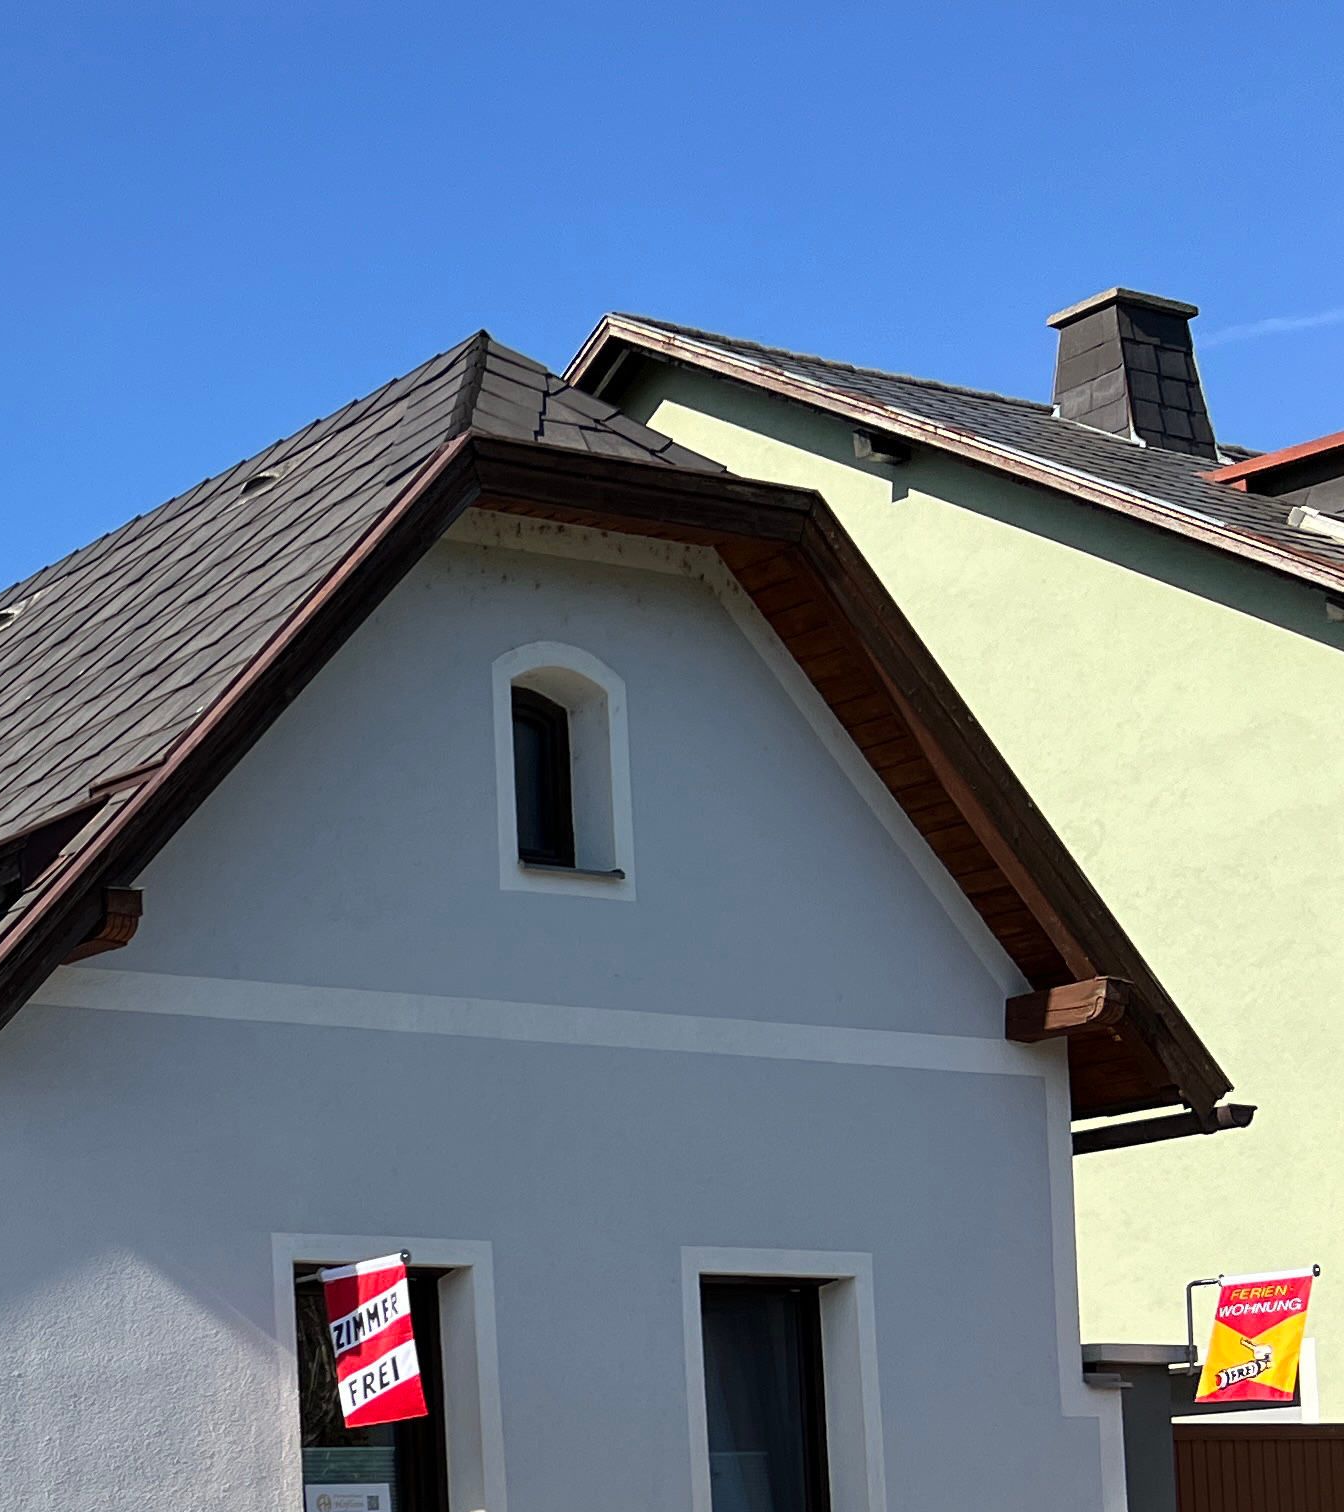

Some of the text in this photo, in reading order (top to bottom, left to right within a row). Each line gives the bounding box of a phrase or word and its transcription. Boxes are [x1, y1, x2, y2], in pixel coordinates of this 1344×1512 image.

[333, 1292, 399, 1351] ZIMMER
[1219, 1298, 1303, 1318] WOHNUNG
[348, 1355, 400, 1407] FREI
[1230, 1364, 1256, 1381] FREI
